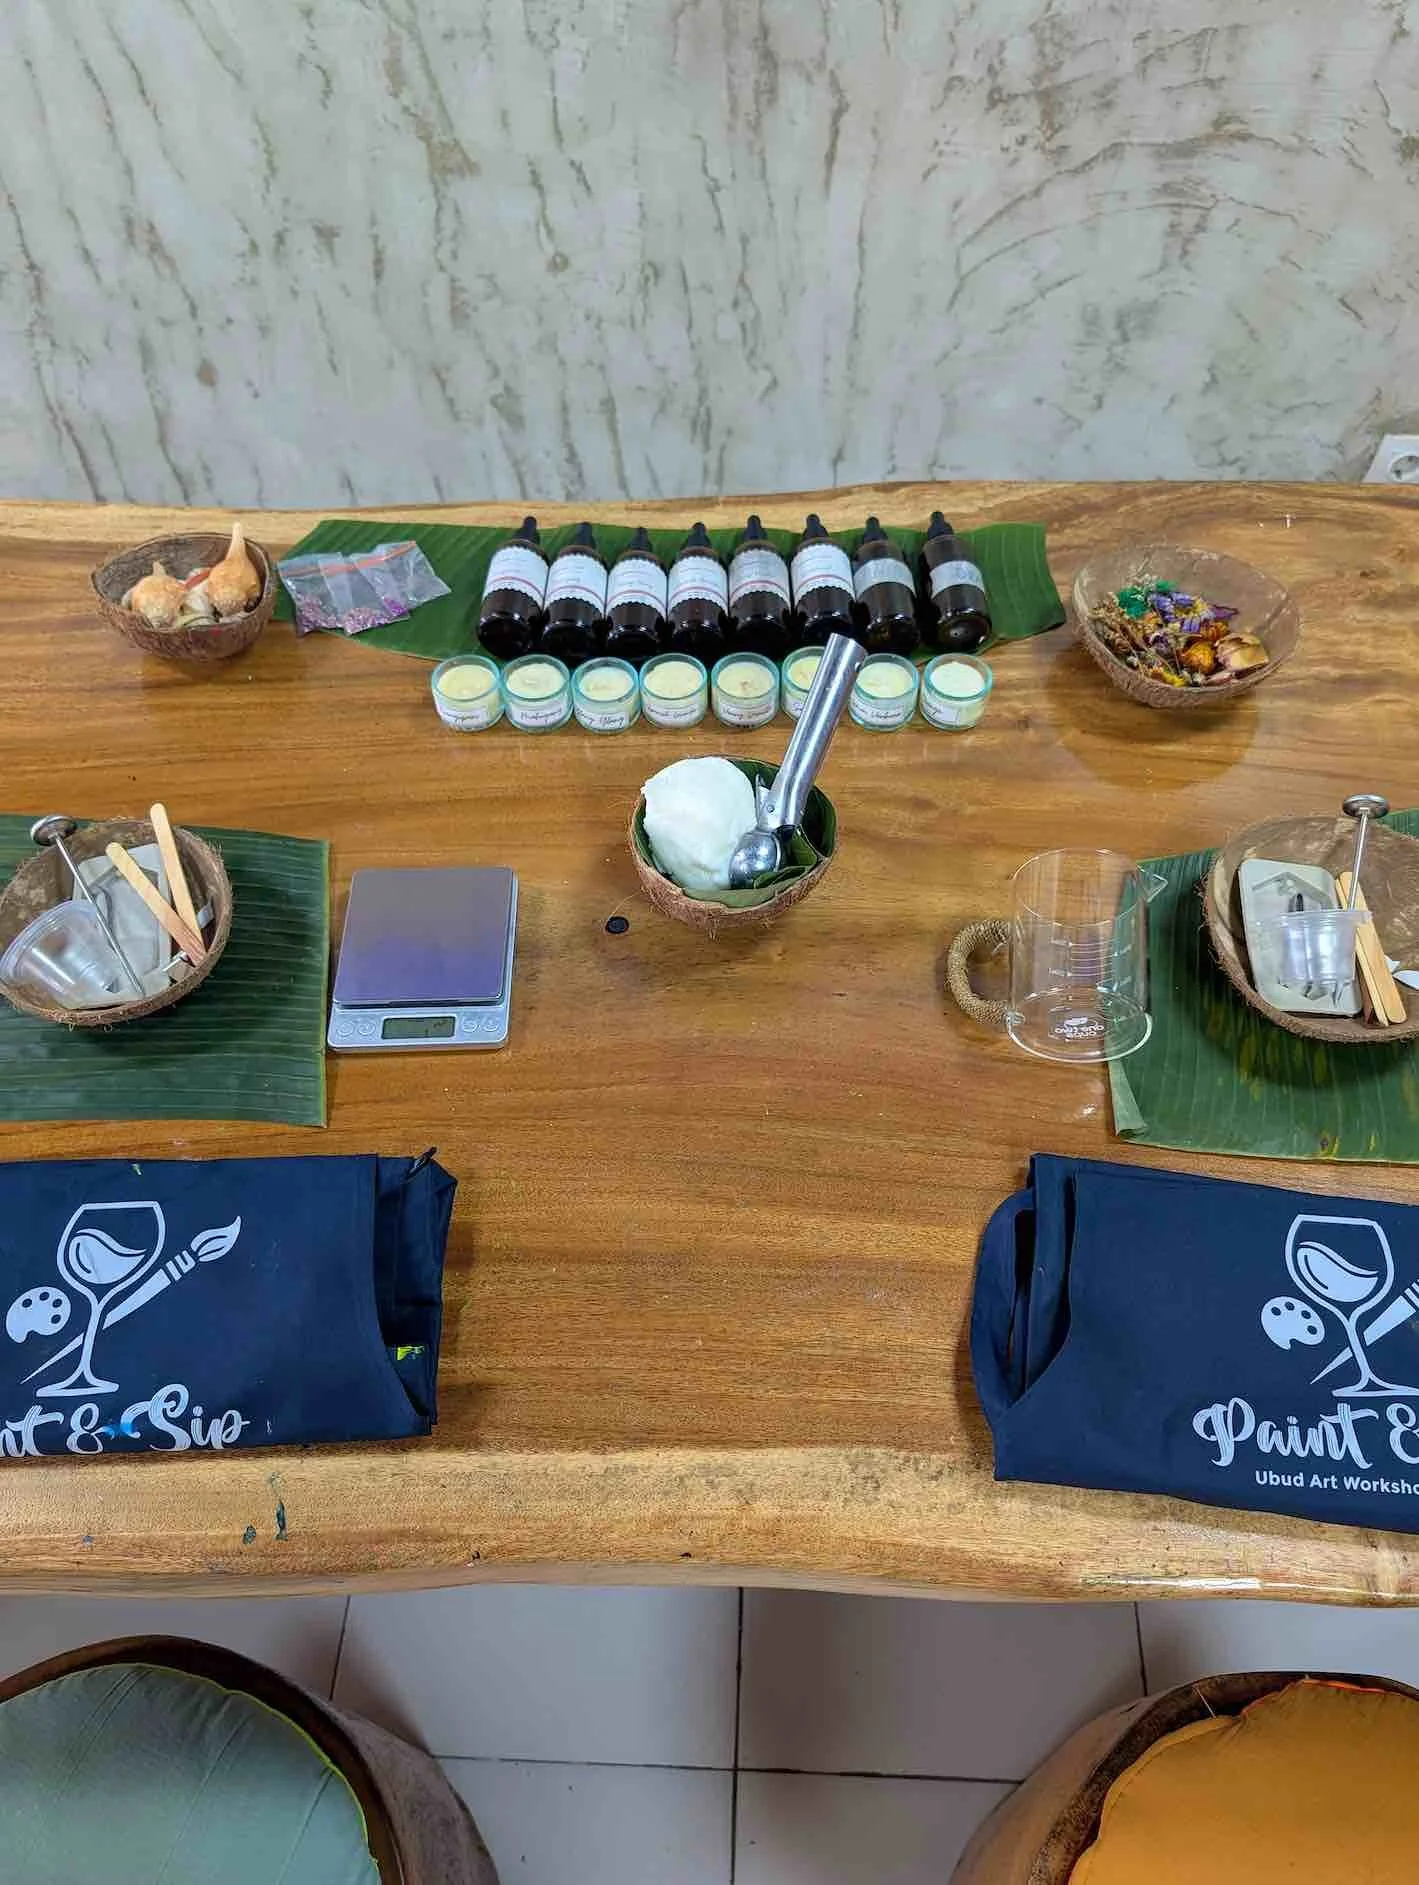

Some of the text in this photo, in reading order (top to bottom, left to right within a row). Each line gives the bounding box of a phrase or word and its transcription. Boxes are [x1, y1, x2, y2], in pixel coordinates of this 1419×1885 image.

[66, 1403, 113, 1454] &
[120, 1383, 250, 1450] Sip
[1192, 1397, 1419, 1469] Paint &
[1255, 1470, 1304, 1488] Ubud
[1310, 1474, 1338, 1490] Art
